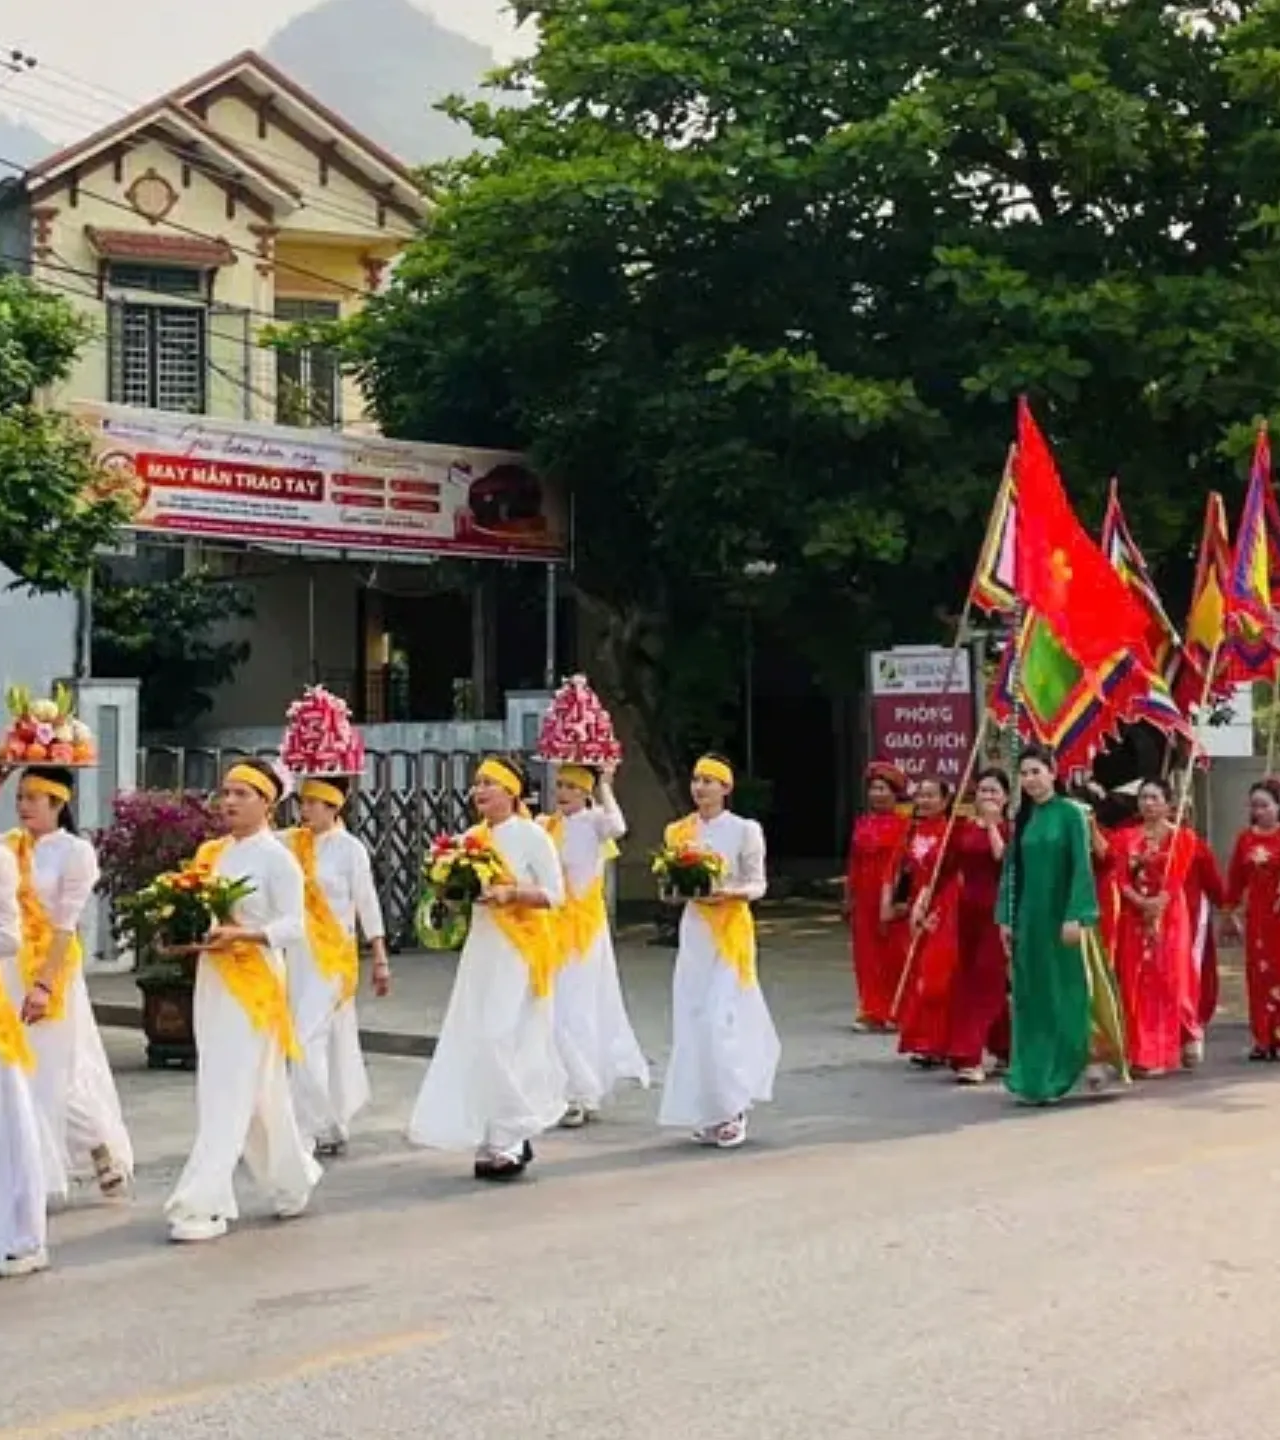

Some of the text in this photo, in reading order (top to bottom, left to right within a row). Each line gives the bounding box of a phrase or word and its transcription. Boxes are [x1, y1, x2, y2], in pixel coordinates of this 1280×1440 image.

[148, 463, 187, 480] MAY
[234, 473, 280, 491] TRAO
[284, 477, 320, 495] TAY
[885, 730, 925, 747] GIAO
